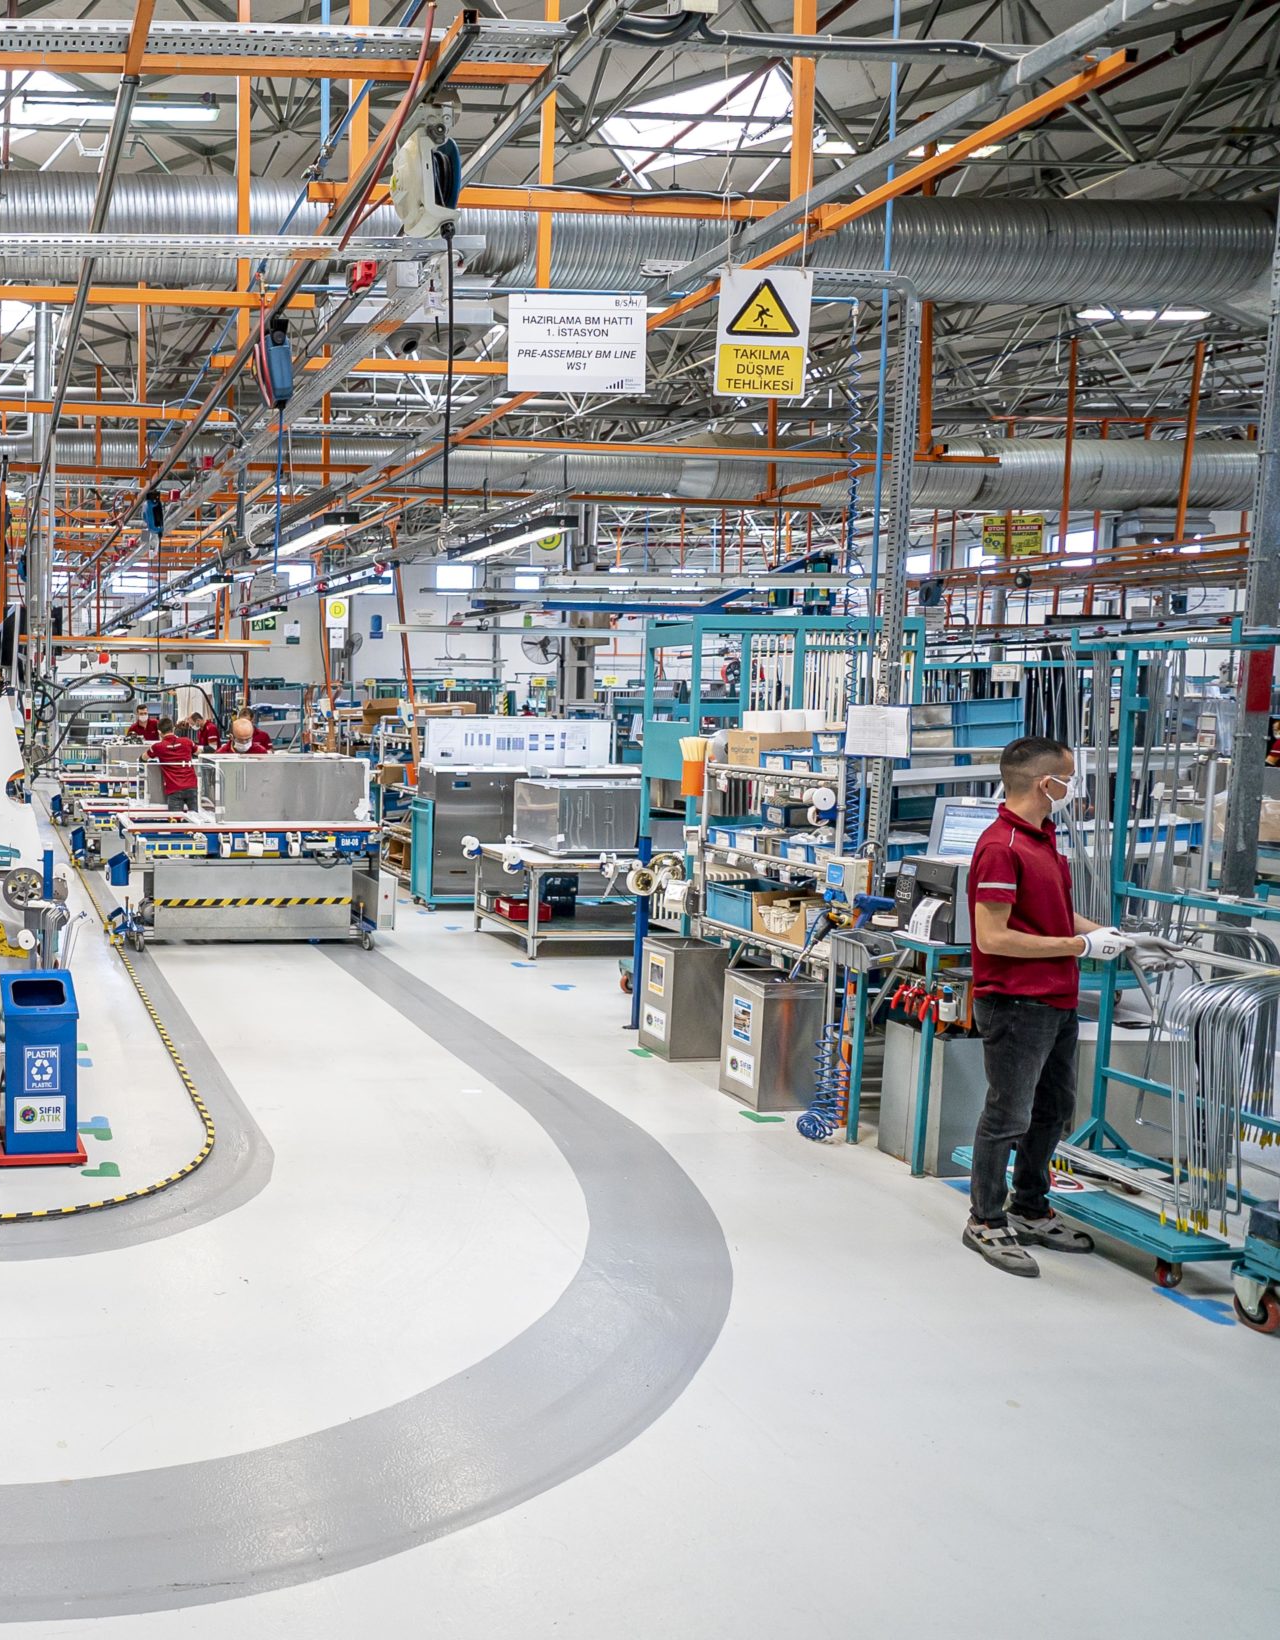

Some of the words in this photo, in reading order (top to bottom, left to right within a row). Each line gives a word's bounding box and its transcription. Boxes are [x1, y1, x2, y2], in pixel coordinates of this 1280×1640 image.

[522, 316, 581, 325] HAZIRLAMA
[584, 316, 601, 325] BM
[603, 317, 633, 326] HATTI
[547, 328, 555, 337] 1.
[557, 326, 609, 337] İSTASYON
[517, 349, 592, 359] PRE-ASSEMBLY
[595, 350, 612, 359] BM
[614, 350, 637, 360] LINE
[733, 348, 790, 360] TAKILMA
[566, 362, 587, 371] WS1
[736, 362, 785, 378] DÜŞME
[726, 378, 794, 391] TEHLİKESİ
[334, 606, 342, 614] D
[341, 838, 359, 846] BM-08
[27, 1050, 58, 1059] PLASTİK
[39, 1106, 61, 1114] SIFIR
[39, 1114, 61, 1122] ATIK
